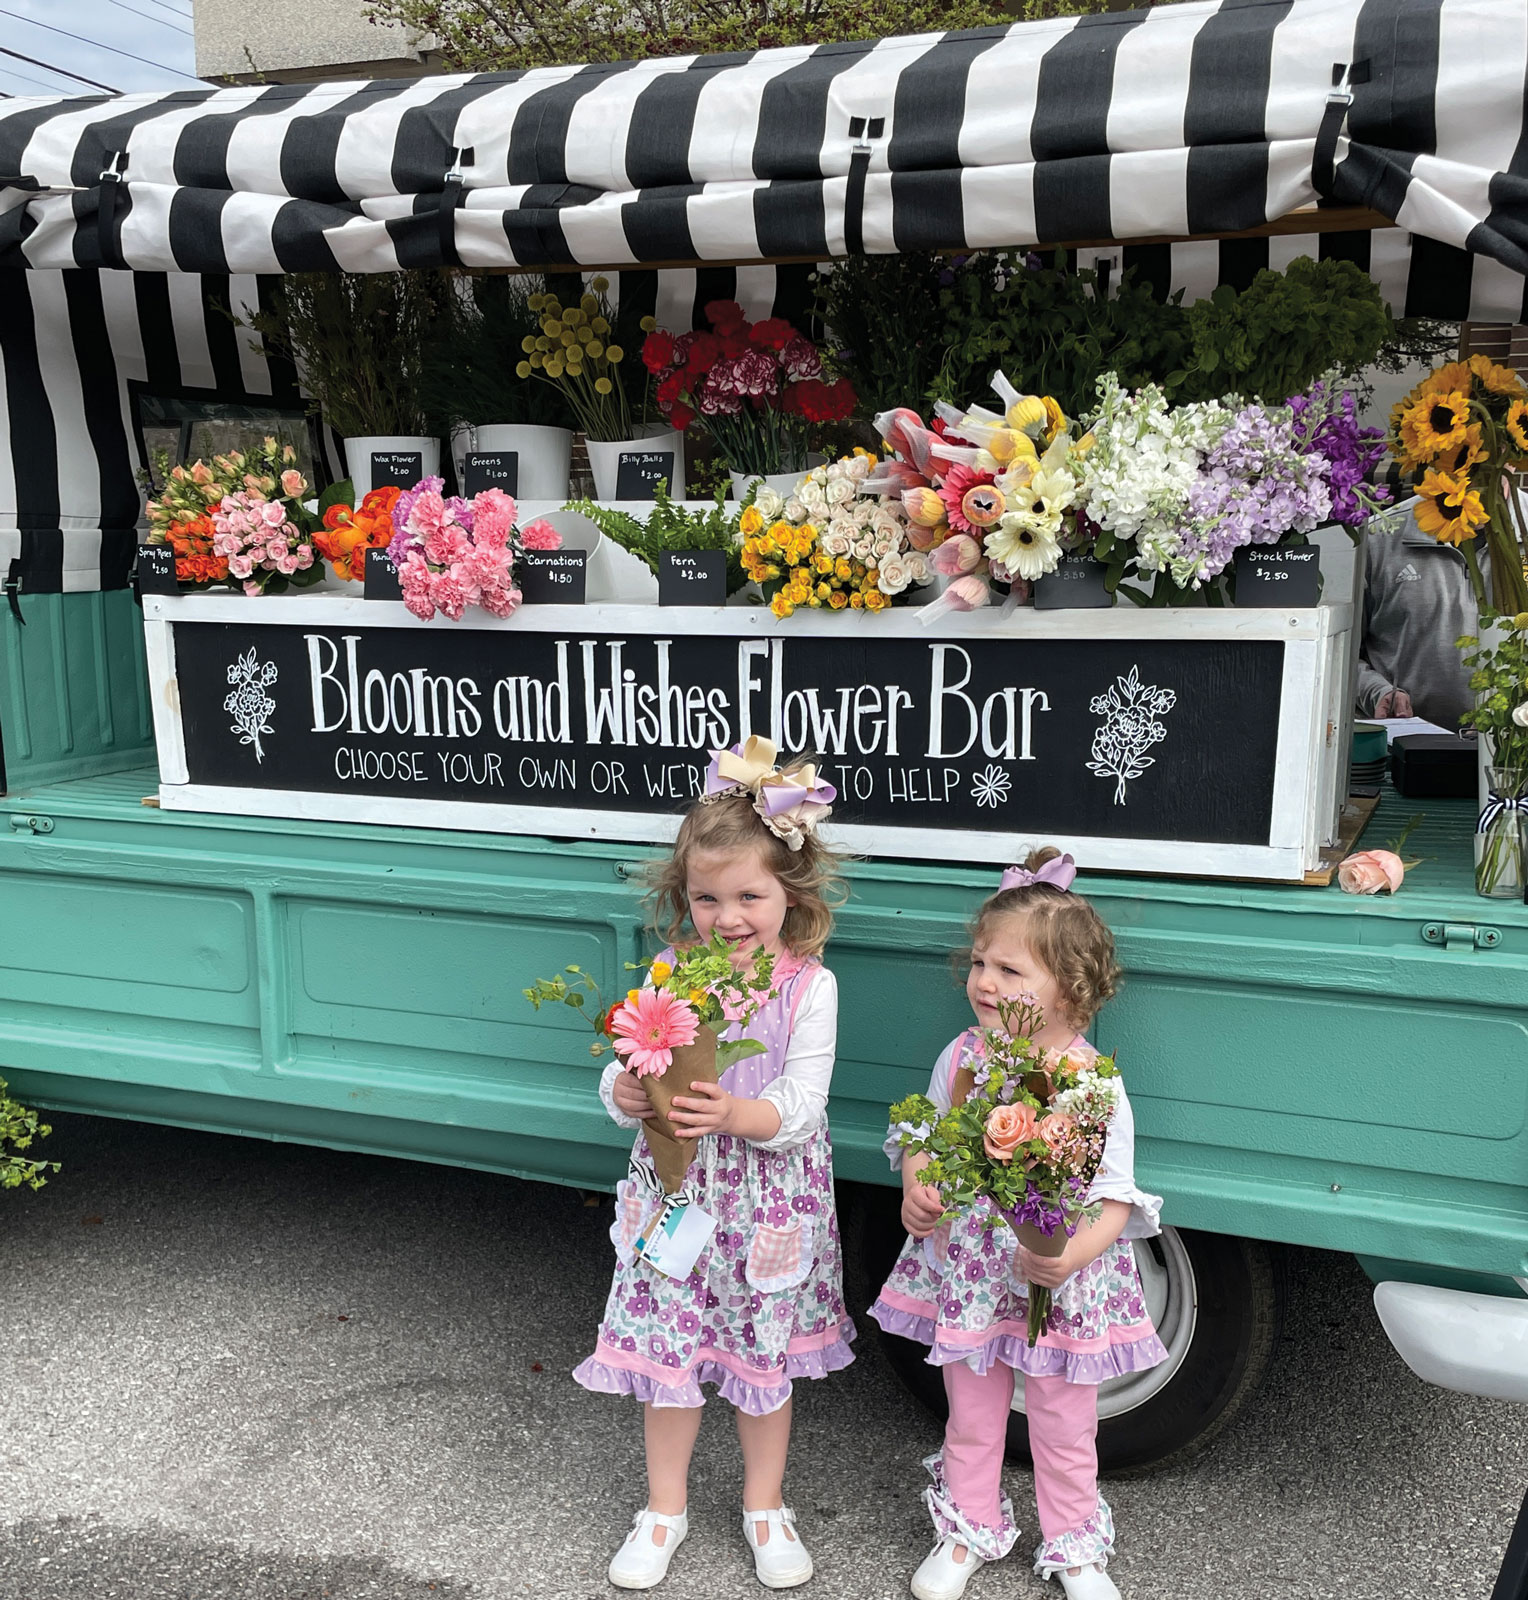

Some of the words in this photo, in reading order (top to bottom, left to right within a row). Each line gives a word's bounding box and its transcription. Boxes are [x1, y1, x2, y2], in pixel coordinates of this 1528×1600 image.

[374, 455, 390, 463] Wax
[391, 455, 416, 463] Flower
[471, 456, 501, 466] Greens
[621, 454, 640, 466] Billy
[641, 454, 663, 464] Balls
[390, 465, 409, 475] $2.00
[641, 469, 662, 480] $2.00
[138, 546, 156, 559] Spray
[1248, 550, 1283, 562] Stock
[1284, 549, 1315, 562] Flower
[527, 554, 584, 567] Carnations
[670, 554, 697, 566] Fern
[152, 562, 168, 574] $2.50
[1255, 567, 1289, 581] $2.50
[548, 569, 573, 584] $1.50
[680, 569, 708, 581] $2.00
[303, 634, 482, 738] Blooms
[493, 640, 574, 743] and
[579, 640, 731, 749] Wishes
[738, 638, 915, 756] Flower
[924, 643, 1052, 760] Bar
[334, 747, 429, 781] CHOOSE
[437, 752, 505, 787] YOUR
[518, 757, 577, 790] OWN
[590, 760, 630, 795] OR
[643, 763, 709, 799] WE'R
[835, 765, 873, 802] TO
[888, 768, 961, 803] HELP
